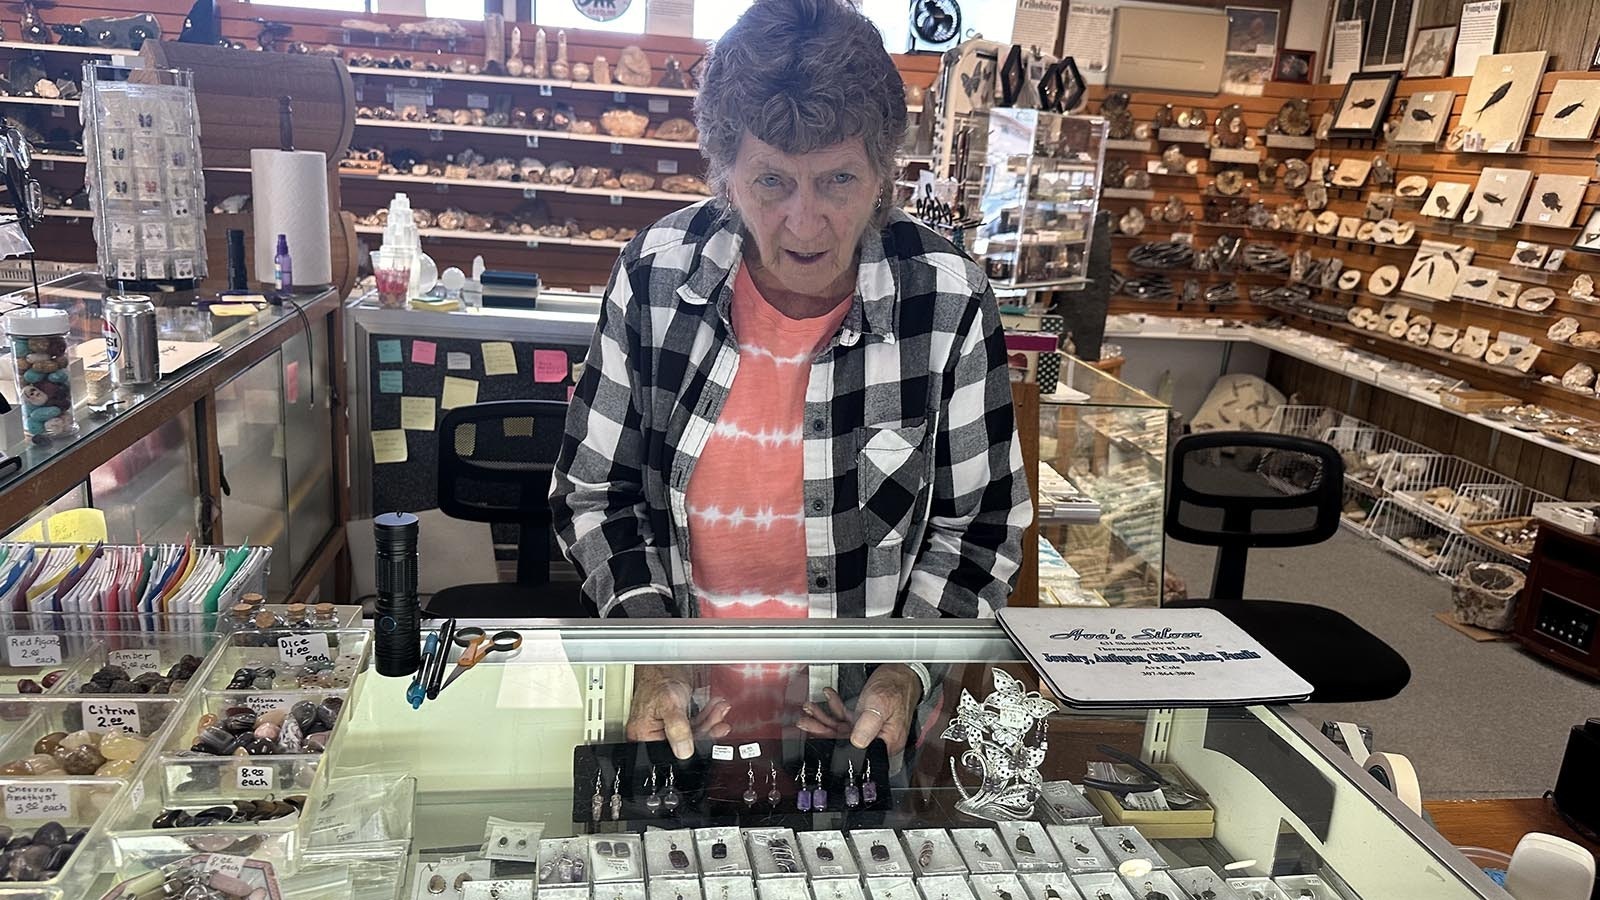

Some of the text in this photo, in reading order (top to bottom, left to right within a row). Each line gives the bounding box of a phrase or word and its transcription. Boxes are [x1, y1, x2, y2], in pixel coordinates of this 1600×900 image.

[1049, 627, 1202, 641] Ava's Silver
[11, 637, 32, 647] Red
[280, 639, 310, 649] Dice
[115, 651, 152, 660] Amber
[285, 647, 311, 657] 4.00
[1041, 652, 1095, 665] Jewelry,
[1216, 649, 1261, 660] Fossils
[35, 655, 57, 664] each
[305, 653, 329, 662] each
[140, 661, 157, 670] each
[88, 704, 137, 716] Citrine
[97, 716, 125, 728] 2.00
[241, 768, 264, 778] 8.00
[241, 778, 269, 787] each
[6, 792, 59, 804] Amethyst
[15, 801, 68, 815] 3.00 each
[220, 864, 241, 872] each
